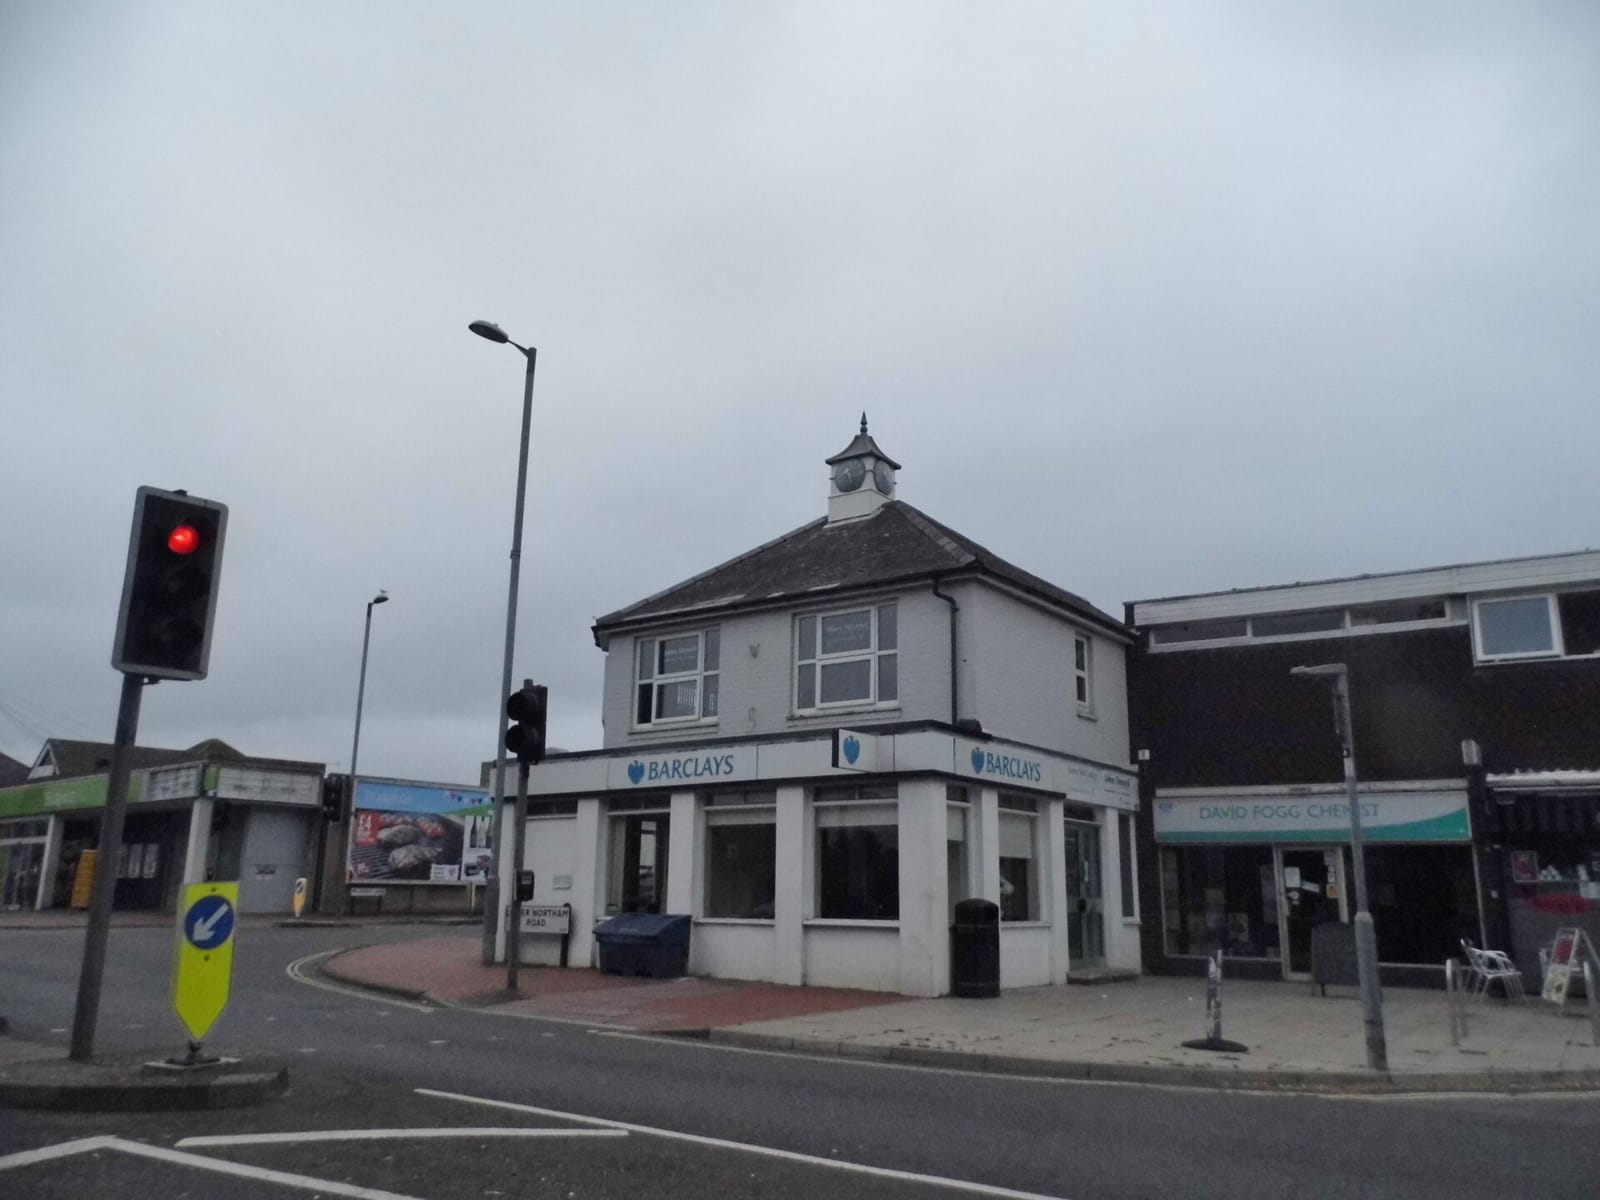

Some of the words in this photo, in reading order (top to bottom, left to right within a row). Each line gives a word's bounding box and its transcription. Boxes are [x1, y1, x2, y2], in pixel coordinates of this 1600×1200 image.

[648, 755, 733, 780] BARCLAYS
[986, 752, 1041, 782] BARCLAYS
[1200, 805, 1248, 819] DAVID
[1253, 804, 1300, 818] FOGG
[1307, 803, 1379, 818] CHEMST
[532, 908, 569, 918] NORTHAM
[526, 918, 546, 927] ROAD
